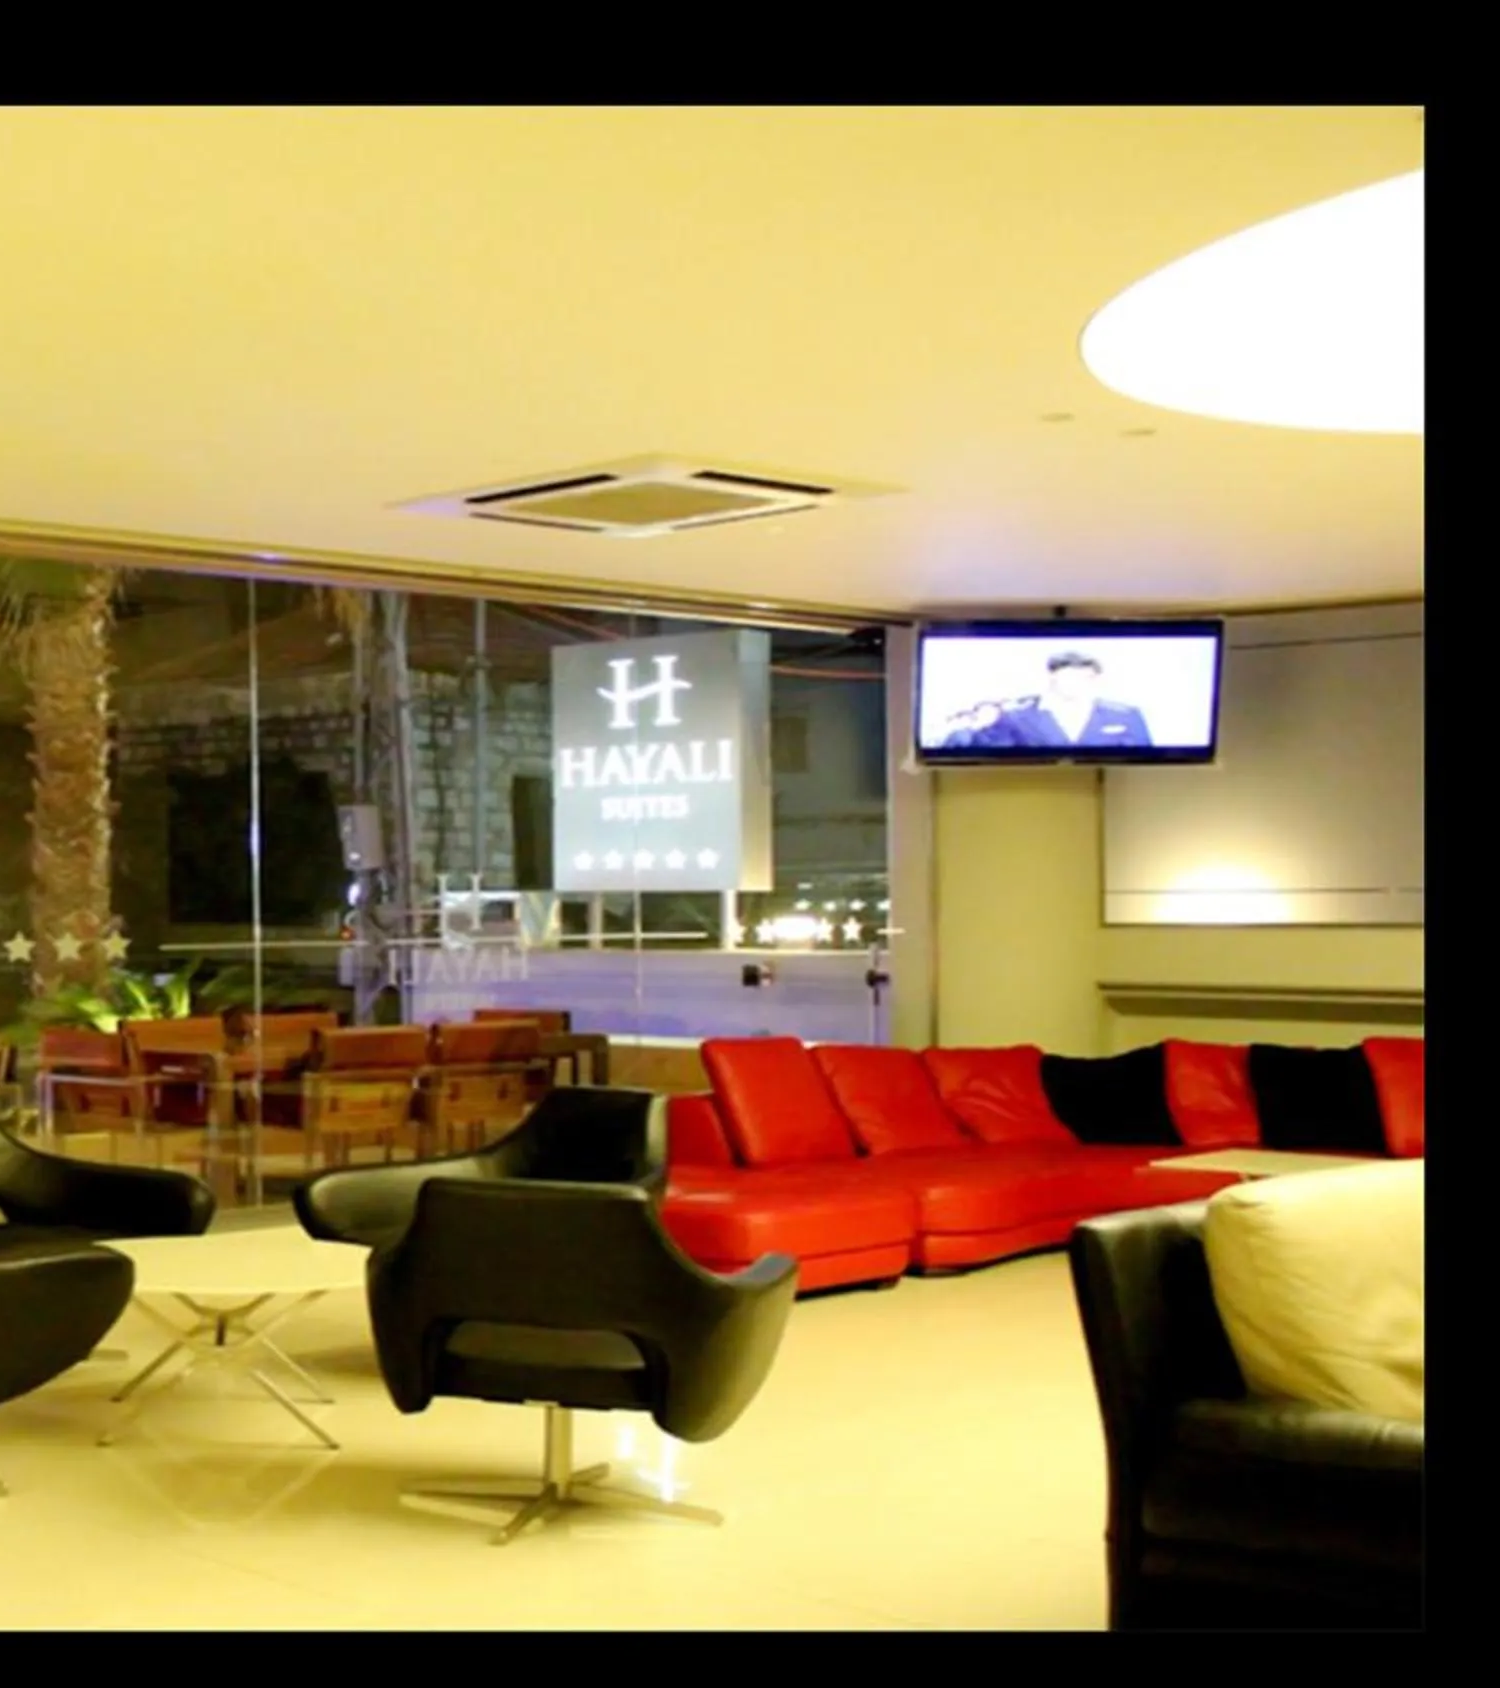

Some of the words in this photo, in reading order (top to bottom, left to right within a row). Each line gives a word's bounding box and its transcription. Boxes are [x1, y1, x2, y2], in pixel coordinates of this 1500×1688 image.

[596, 655, 692, 729] H
[560, 738, 734, 788] HAYALI
[601, 795, 690, 821] SUITES
